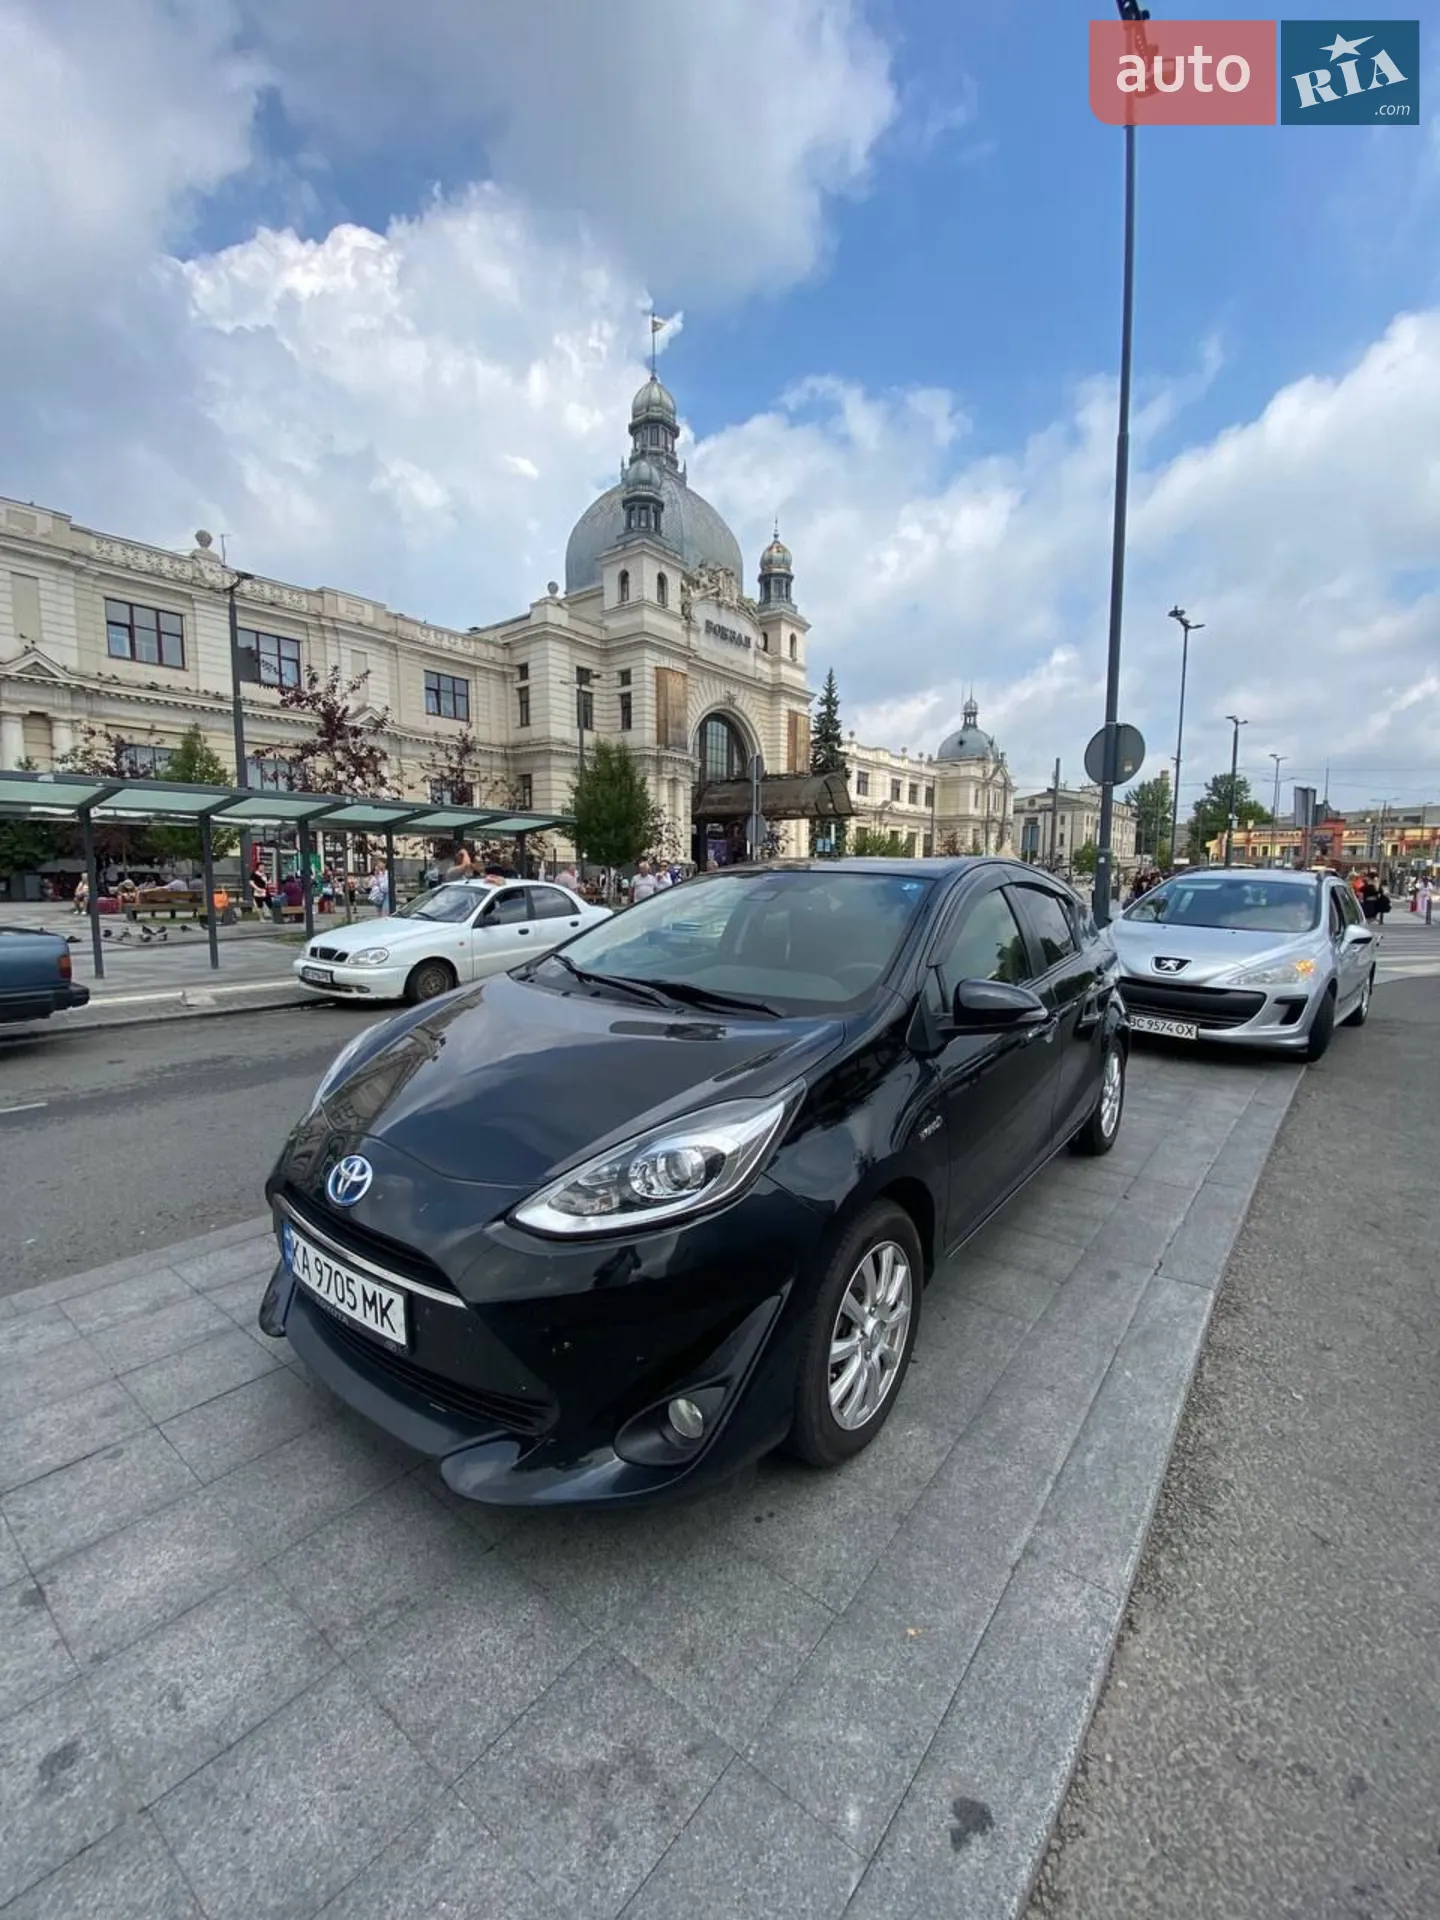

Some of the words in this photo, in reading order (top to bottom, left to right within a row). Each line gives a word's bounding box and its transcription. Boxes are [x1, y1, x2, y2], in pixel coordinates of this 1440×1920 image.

[1147, 1019, 1173, 1033] 9574
[1175, 1024, 1194, 1037] OX
[293, 1240, 311, 1281] KA
[314, 1256, 357, 1311] 9705
[361, 1283, 397, 1334] MK
